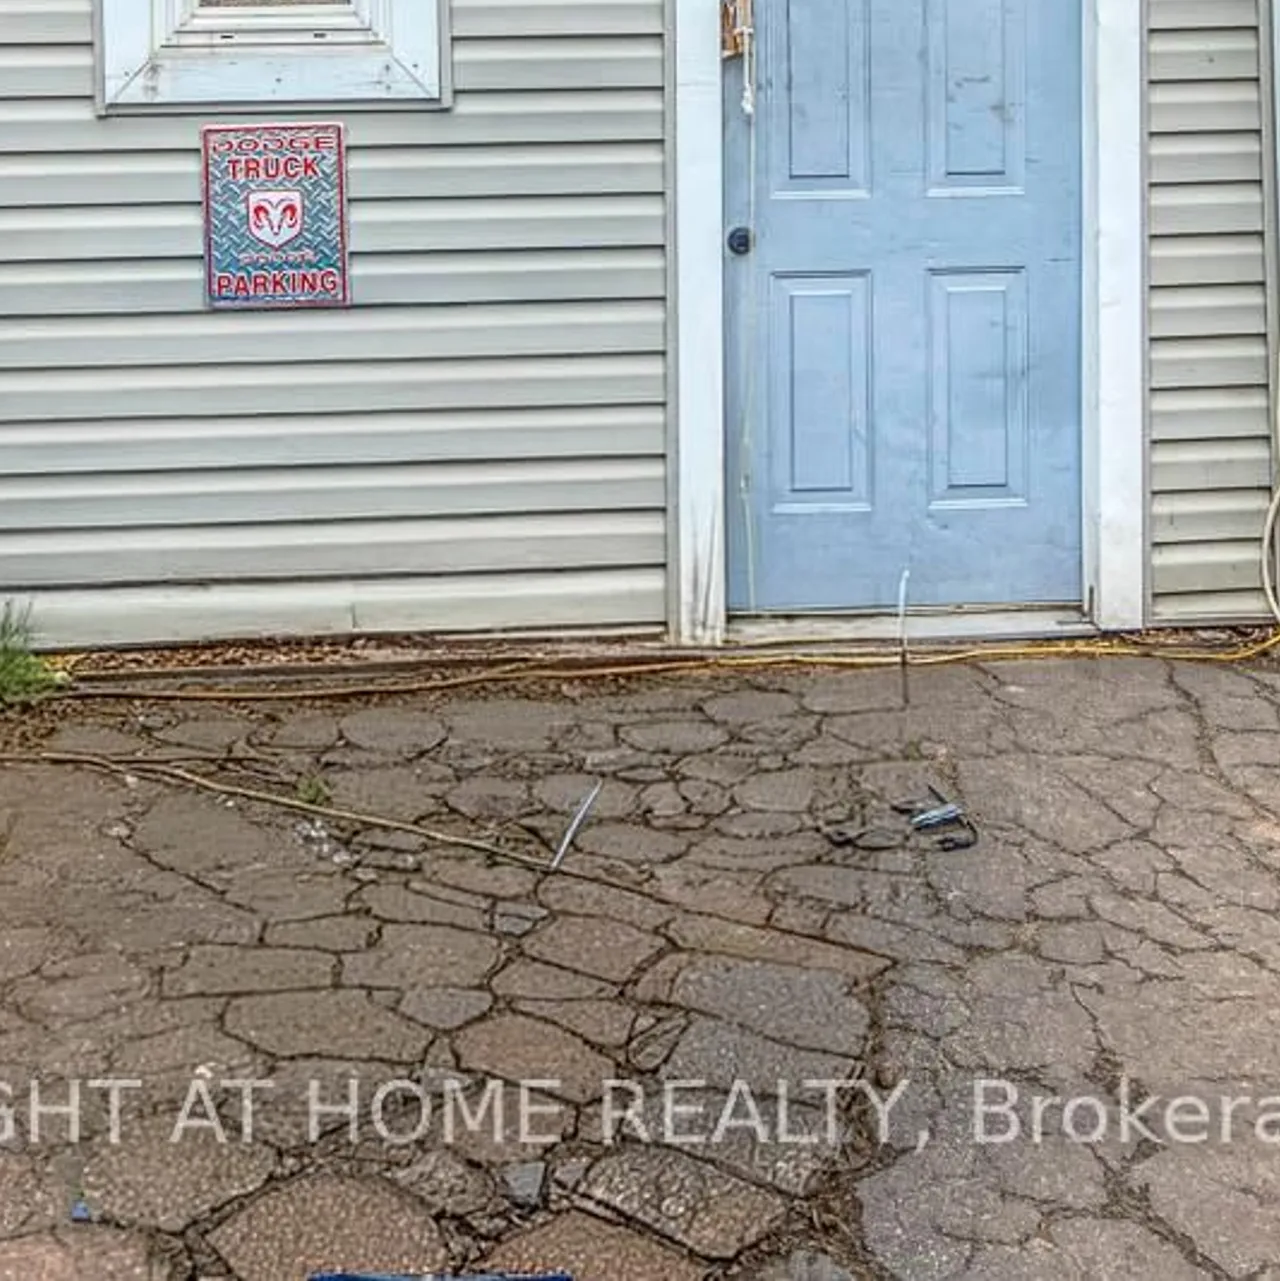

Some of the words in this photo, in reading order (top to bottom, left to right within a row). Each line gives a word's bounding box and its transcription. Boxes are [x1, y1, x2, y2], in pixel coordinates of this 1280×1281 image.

[213, 135, 335, 153] DODGE
[228, 157, 320, 180] TRUCK
[217, 270, 338, 297] PARKING
